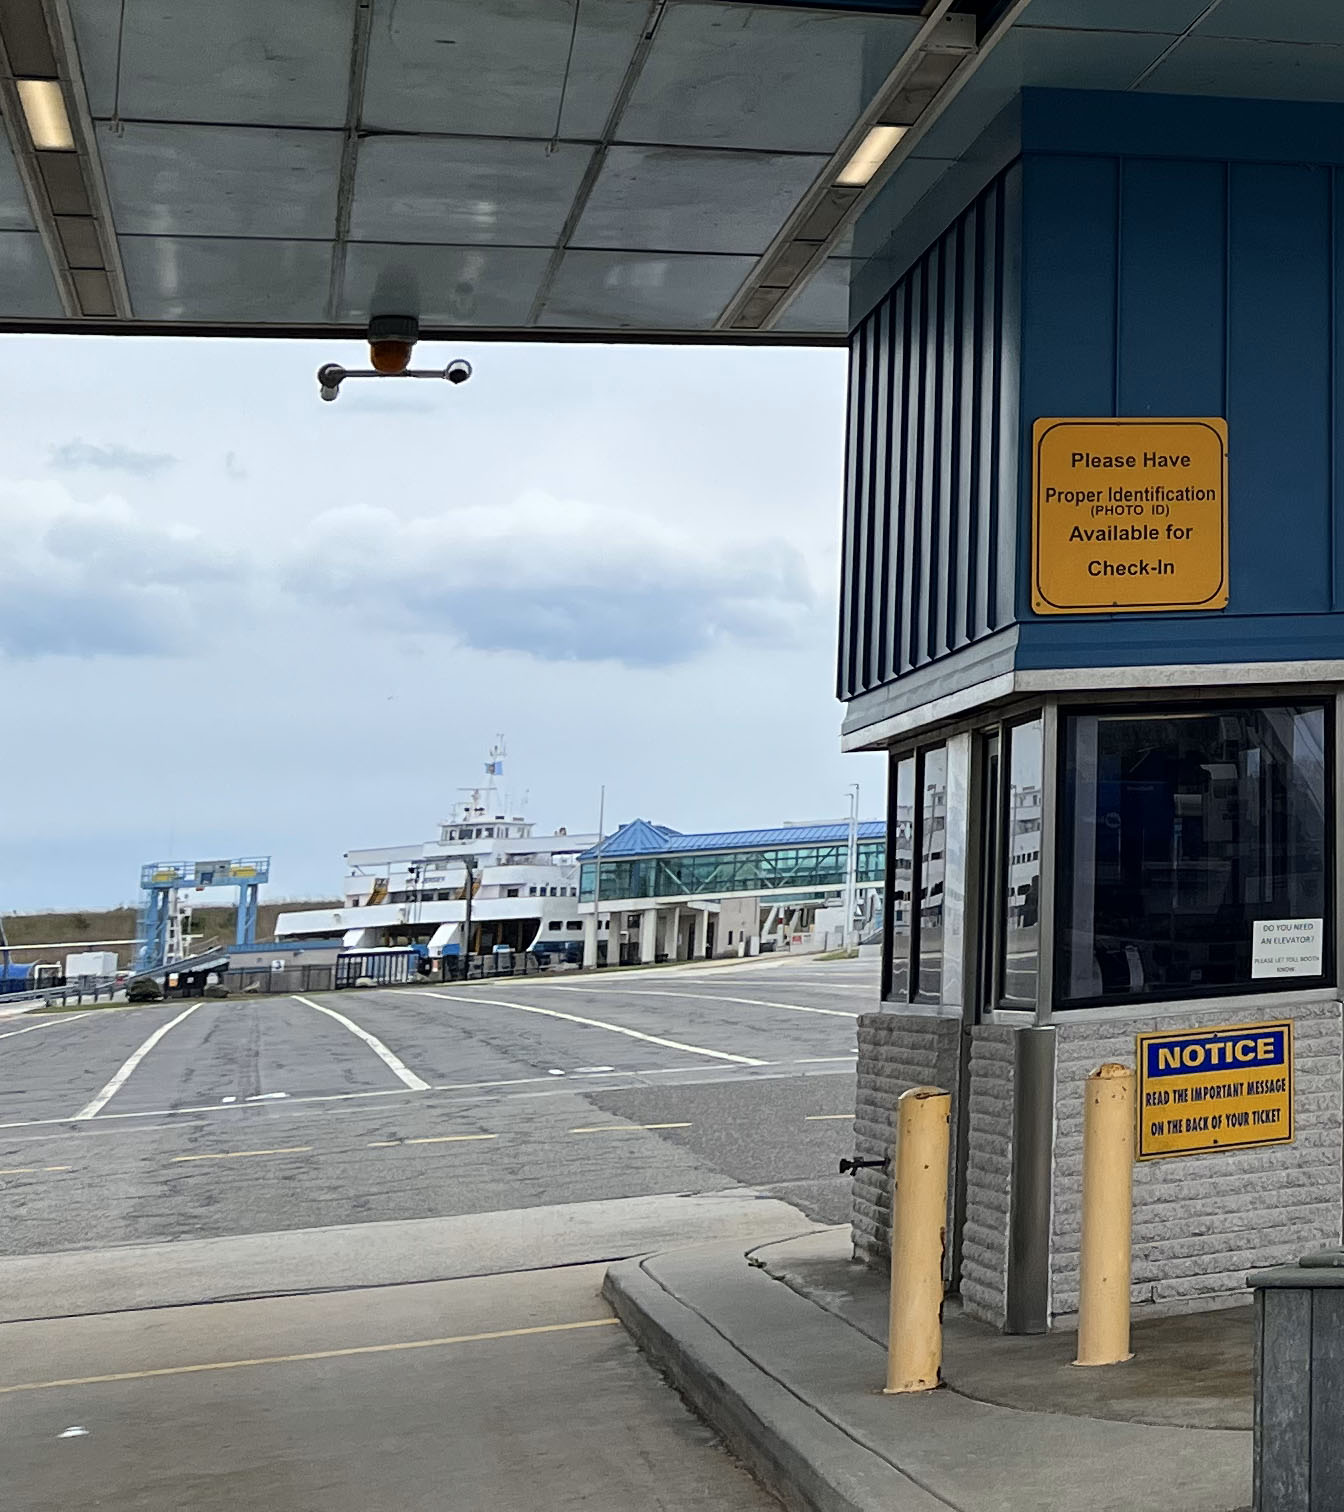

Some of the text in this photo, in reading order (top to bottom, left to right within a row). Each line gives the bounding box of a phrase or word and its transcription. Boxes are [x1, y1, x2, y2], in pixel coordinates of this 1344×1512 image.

[1071, 451, 1191, 468] Please Have
[1045, 486, 1216, 506] Proper Identification
[1090, 504, 1170, 518] (PHOTO ID)
[1068, 524, 1193, 542] Available for
[1087, 559, 1175, 576] Check-In
[1263, 924, 1275, 932] DO
[1293, 923, 1314, 931] NEED
[1274, 936, 1315, 944] ELEVATOR?
[1157, 1037, 1275, 1070] NOTICE
[1145, 1078, 1286, 1107] READ THE IMPORTANT MESSAGE
[1150, 1108, 1282, 1137] ON THE BACK OF YOUR TICKET
